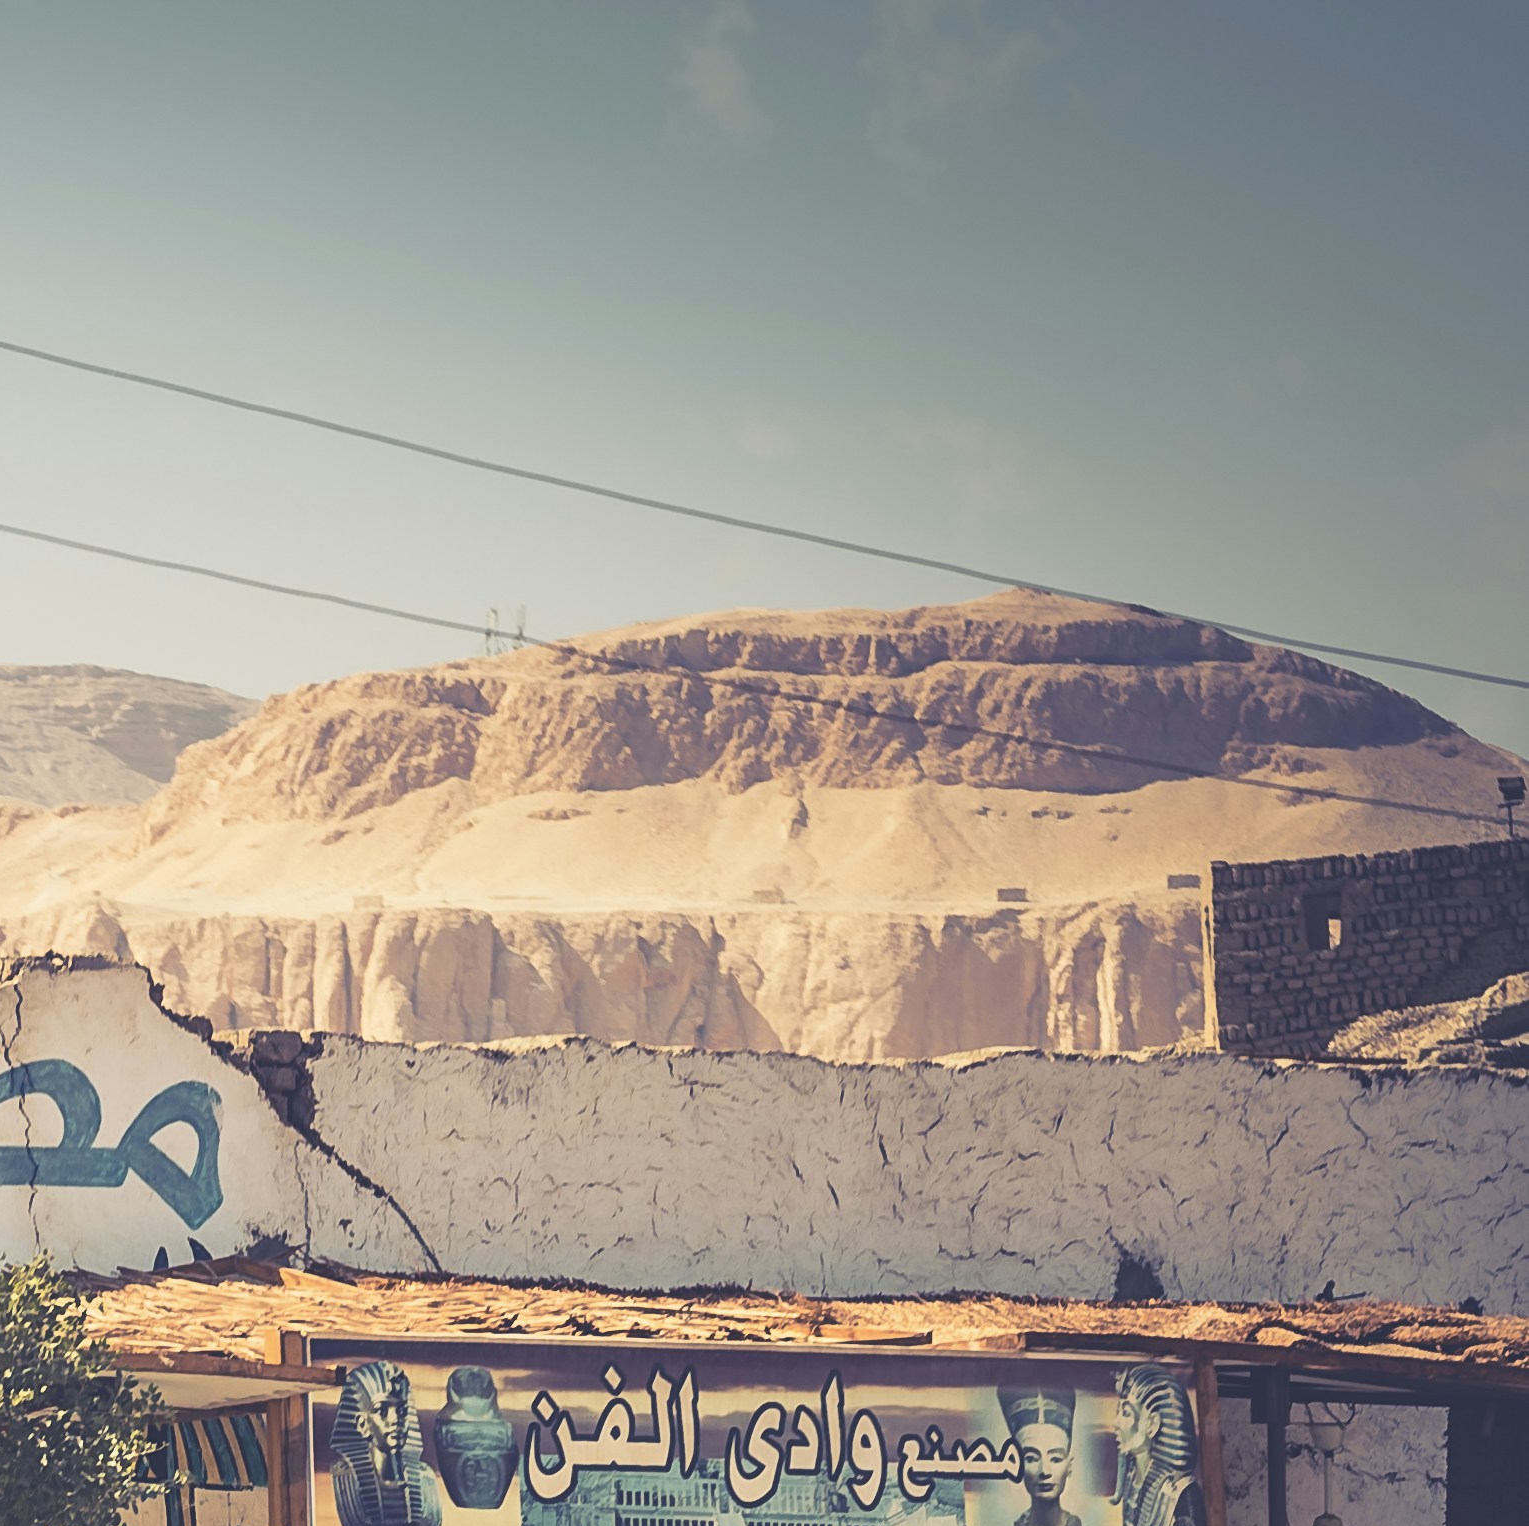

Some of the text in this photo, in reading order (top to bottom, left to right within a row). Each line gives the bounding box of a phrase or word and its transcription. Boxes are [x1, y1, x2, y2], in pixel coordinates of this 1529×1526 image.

[524, 1362, 1025, 1510] مصنع وادى الفن
